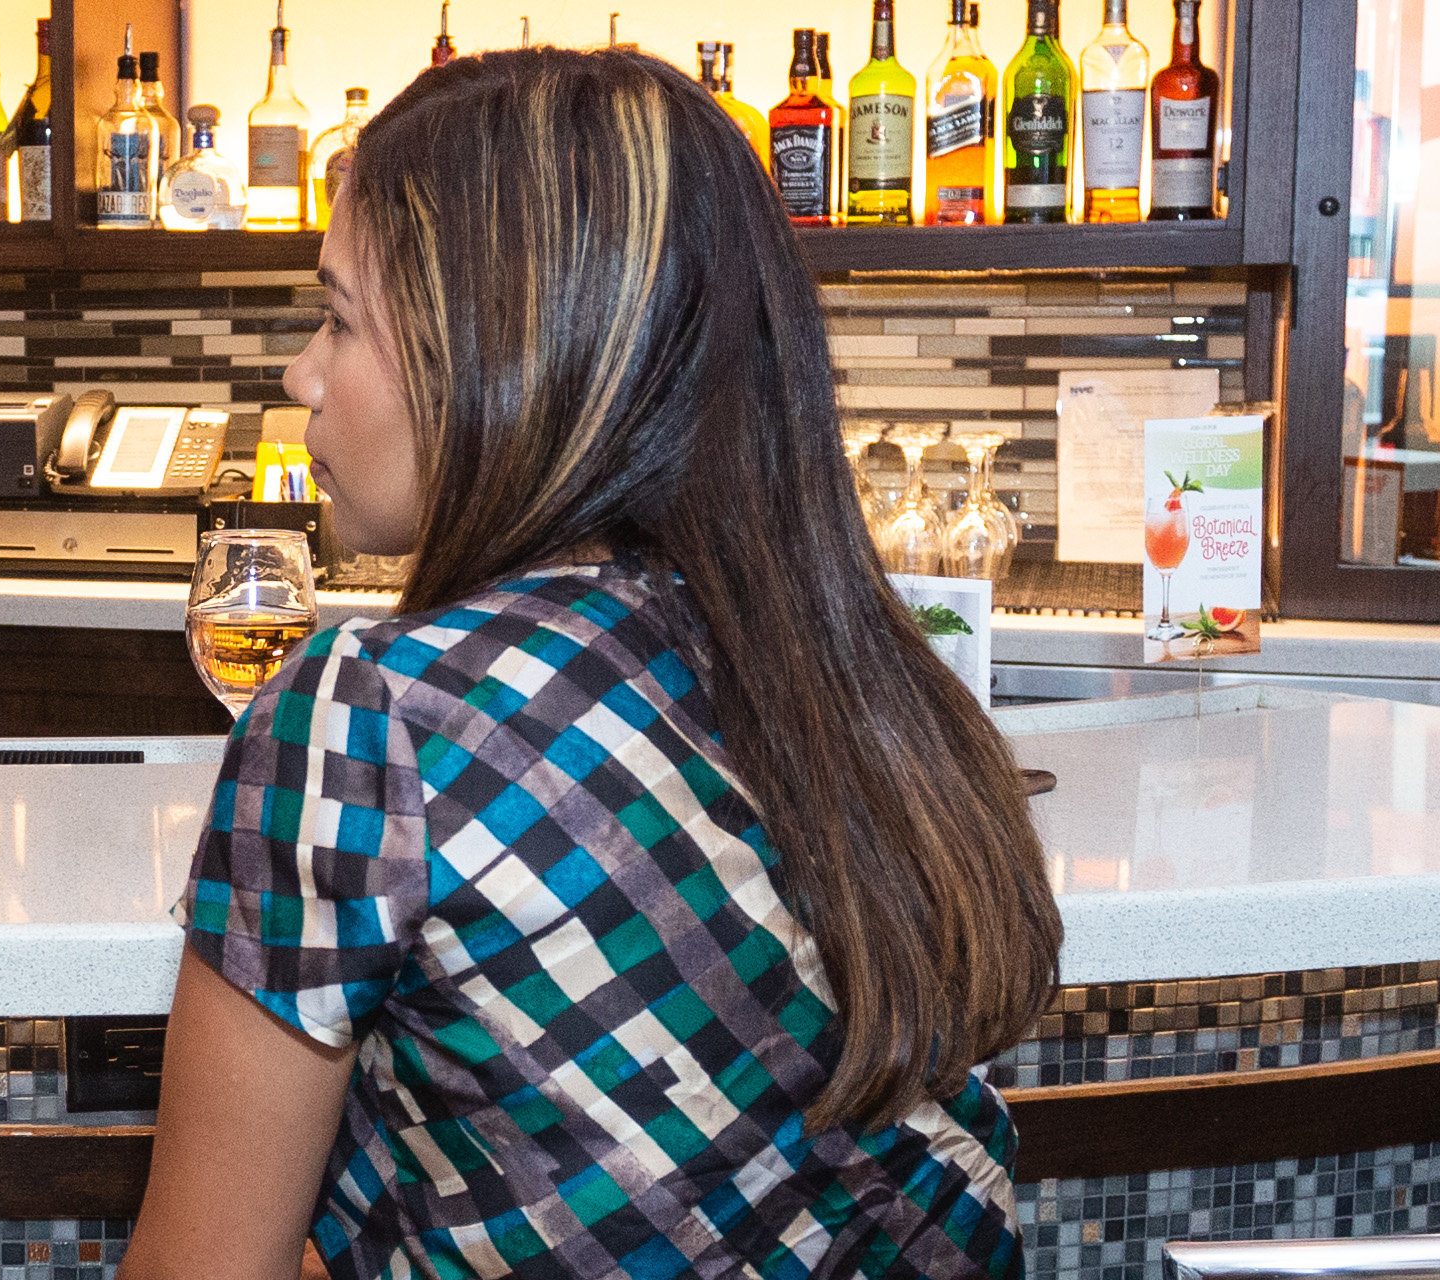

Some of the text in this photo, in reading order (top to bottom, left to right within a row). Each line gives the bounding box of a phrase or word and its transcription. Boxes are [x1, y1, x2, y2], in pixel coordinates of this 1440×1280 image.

[851, 102, 909, 120] JAMESON
[98, 192, 151, 213] AZADRES
[1182, 436, 1227, 450] GLOBAL
[1170, 448, 1241, 464] WELLNESS
[1205, 463, 1232, 478] DAY
[1192, 515, 1258, 540] Botanical
